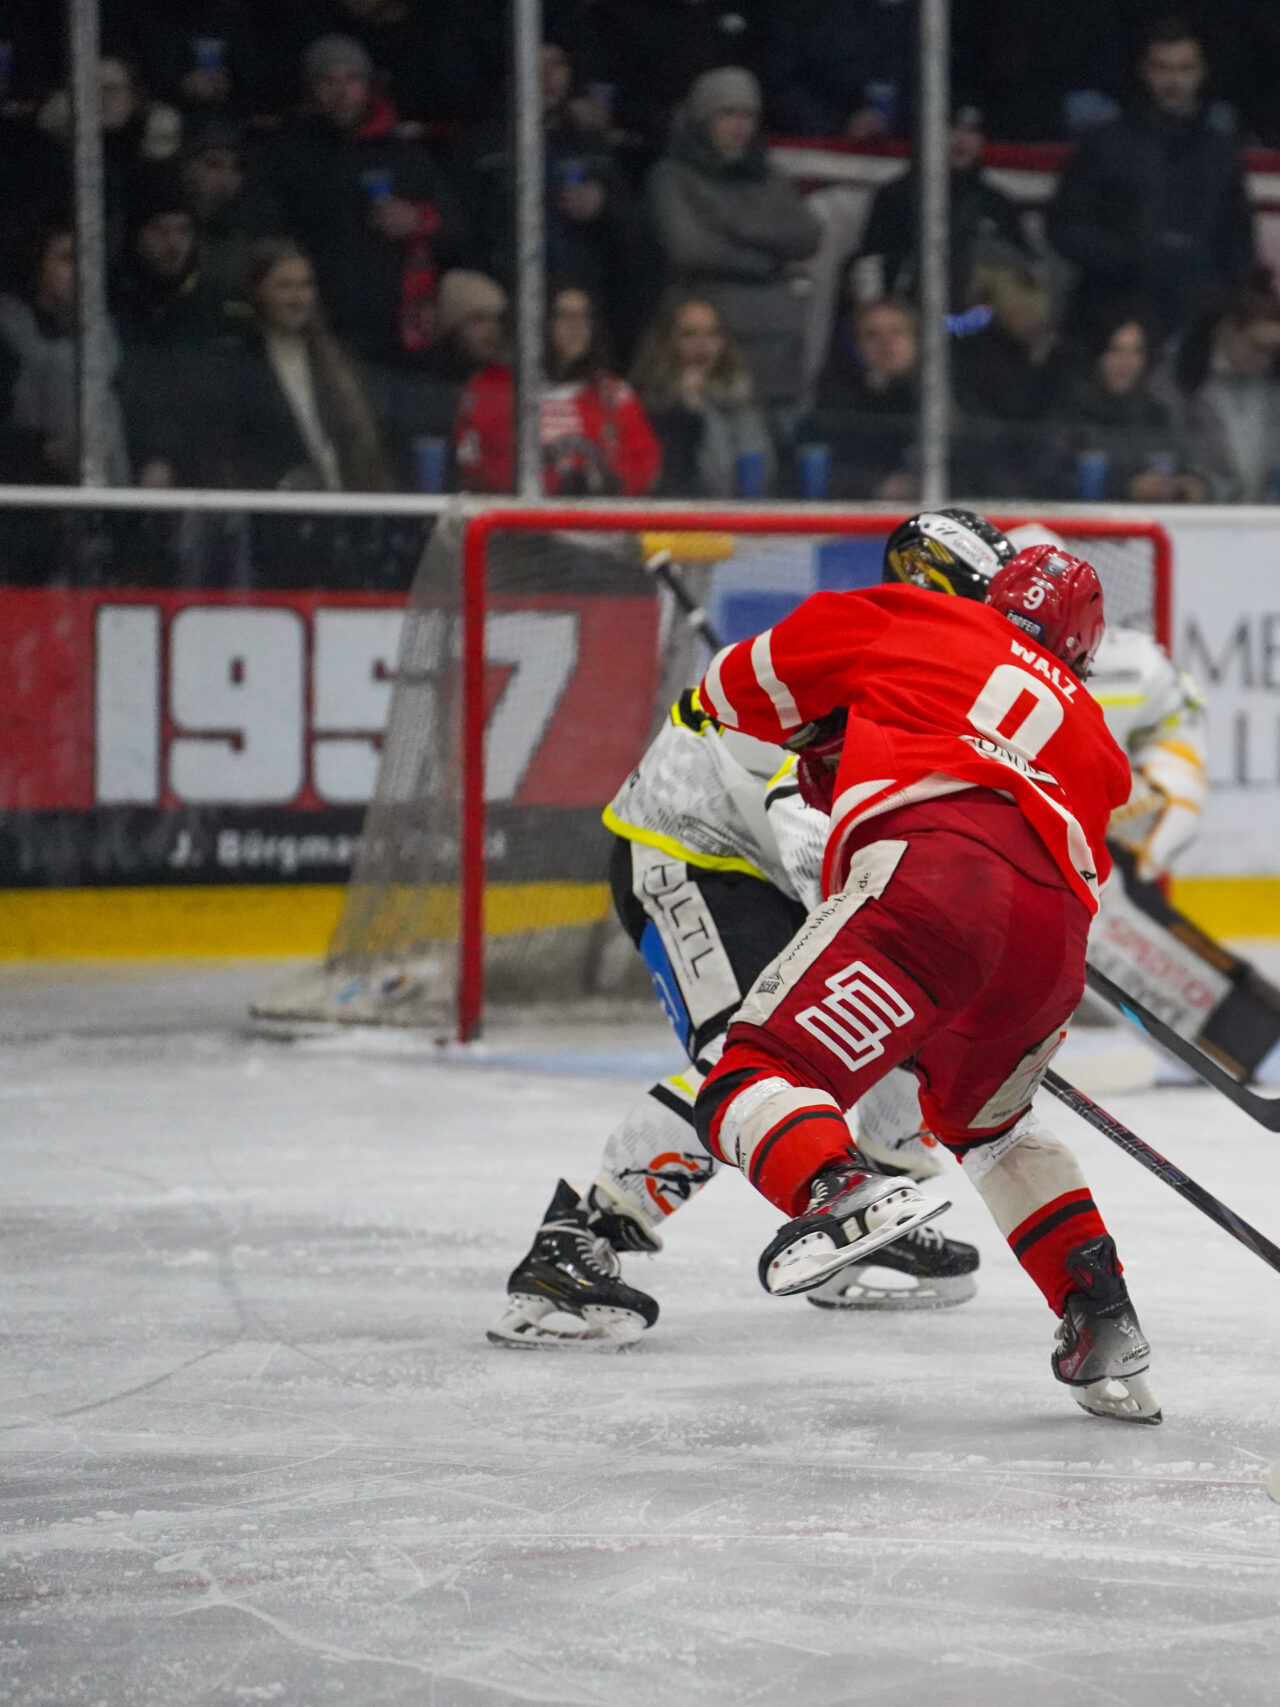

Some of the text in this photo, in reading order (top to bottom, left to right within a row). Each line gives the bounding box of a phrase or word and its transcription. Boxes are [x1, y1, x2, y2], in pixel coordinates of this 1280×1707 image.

[1023, 586, 1046, 610] 9
[1010, 639, 1077, 703] WALZ
[93, 604, 579, 803] 1957
